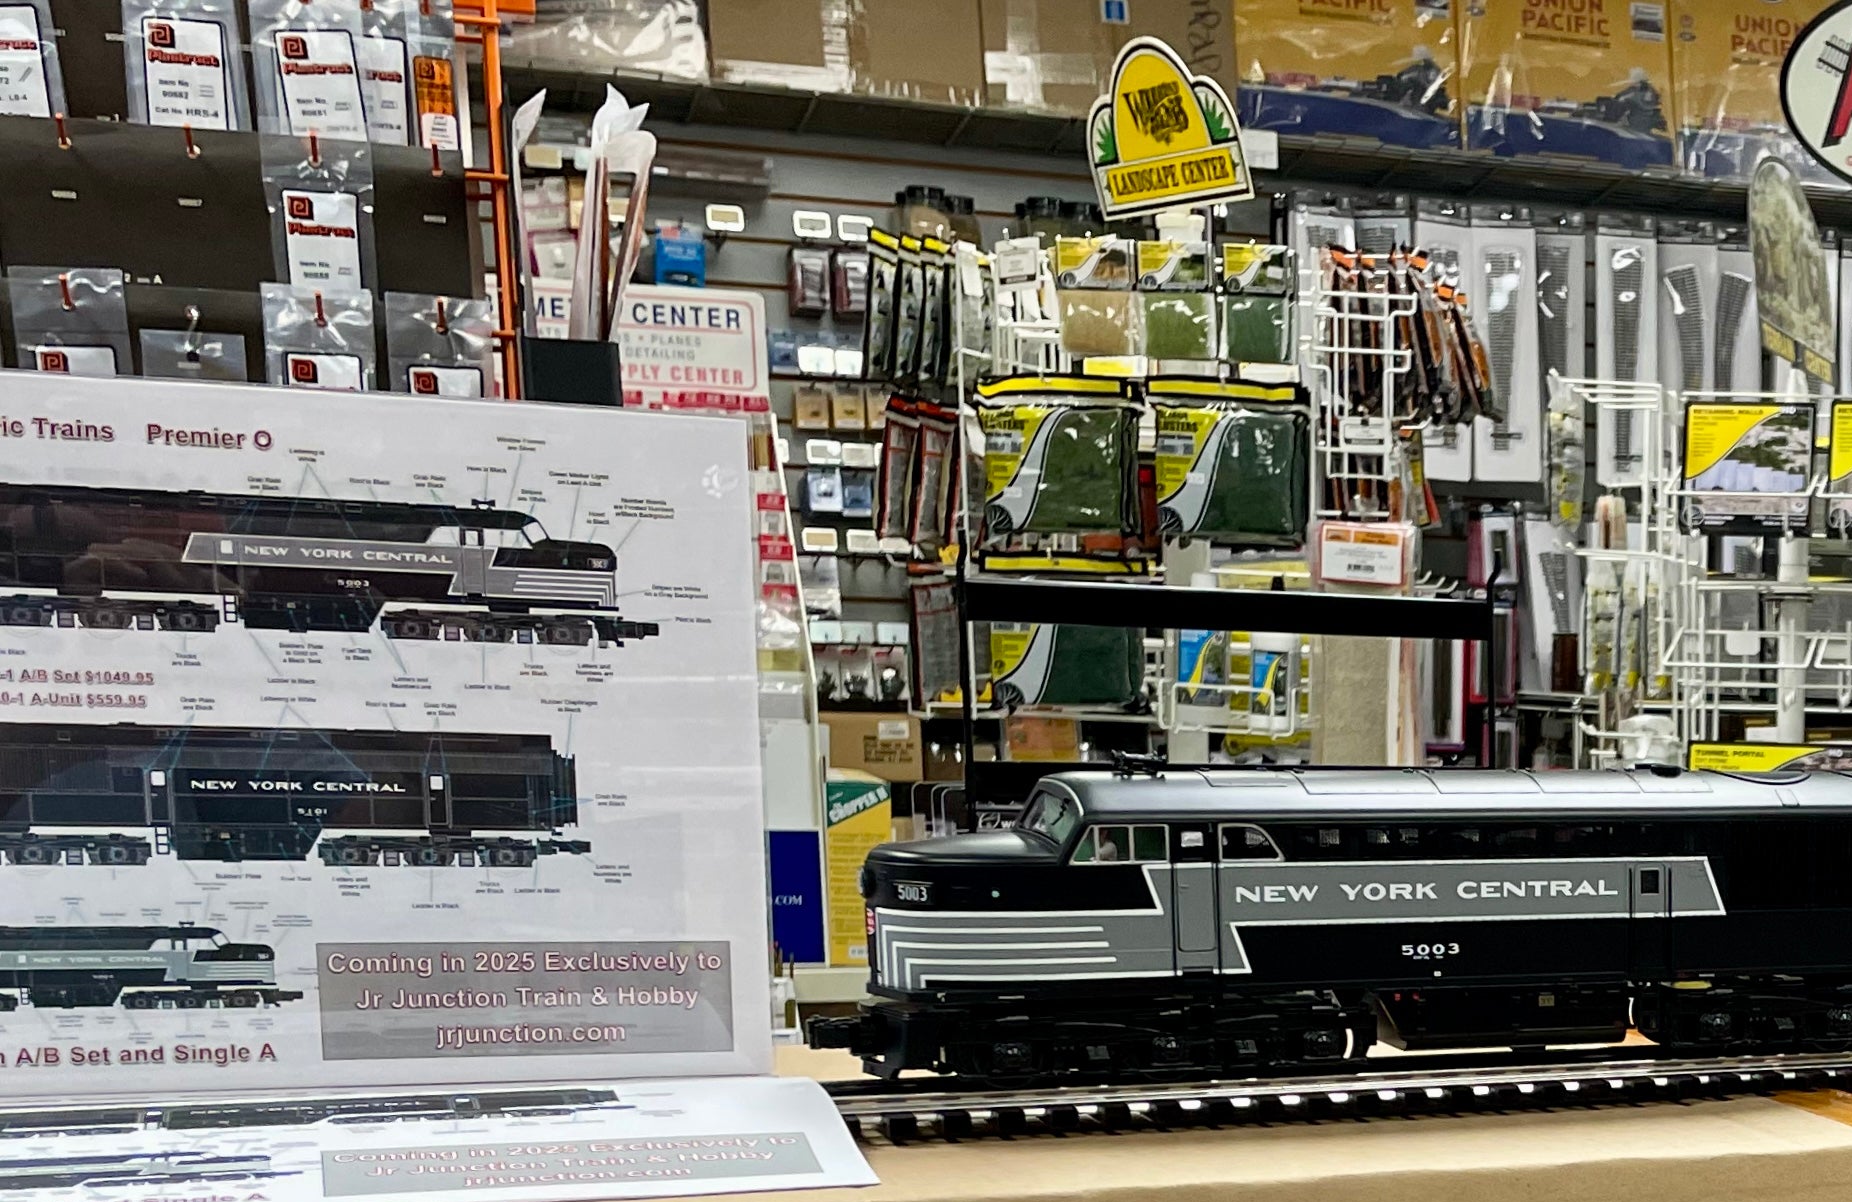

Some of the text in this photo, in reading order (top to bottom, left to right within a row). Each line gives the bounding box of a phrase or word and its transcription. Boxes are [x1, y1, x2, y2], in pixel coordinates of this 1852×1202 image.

[1522, 10, 1610, 36] PACIFIC
[1732, 34, 1791, 55] PACIF
[1112, 156, 1229, 196] LANDSCAPE CENTER
[633, 303, 740, 329] CENTER
[626, 347, 697, 361] DETAILING
[670, 365, 744, 386] CENTER
[32, 417, 273, 450] Trains Premier O
[244, 544, 453, 565] NEW YORK CENTRAL
[191, 779, 406, 793] NEW YORK CENTRAL
[897, 885, 928, 901] 5003
[1235, 879, 1618, 903] NEW YORK CENTRAL
[1401, 942, 1460, 957] 5003
[327, 950, 722, 977] Coming in 2025 Exclusively to
[356, 986, 700, 1010] Jr Junction Train & Hobby
[437, 1024, 626, 1050] jrjunction.com
[16, 1042, 279, 1067] A/B Set and Single A
